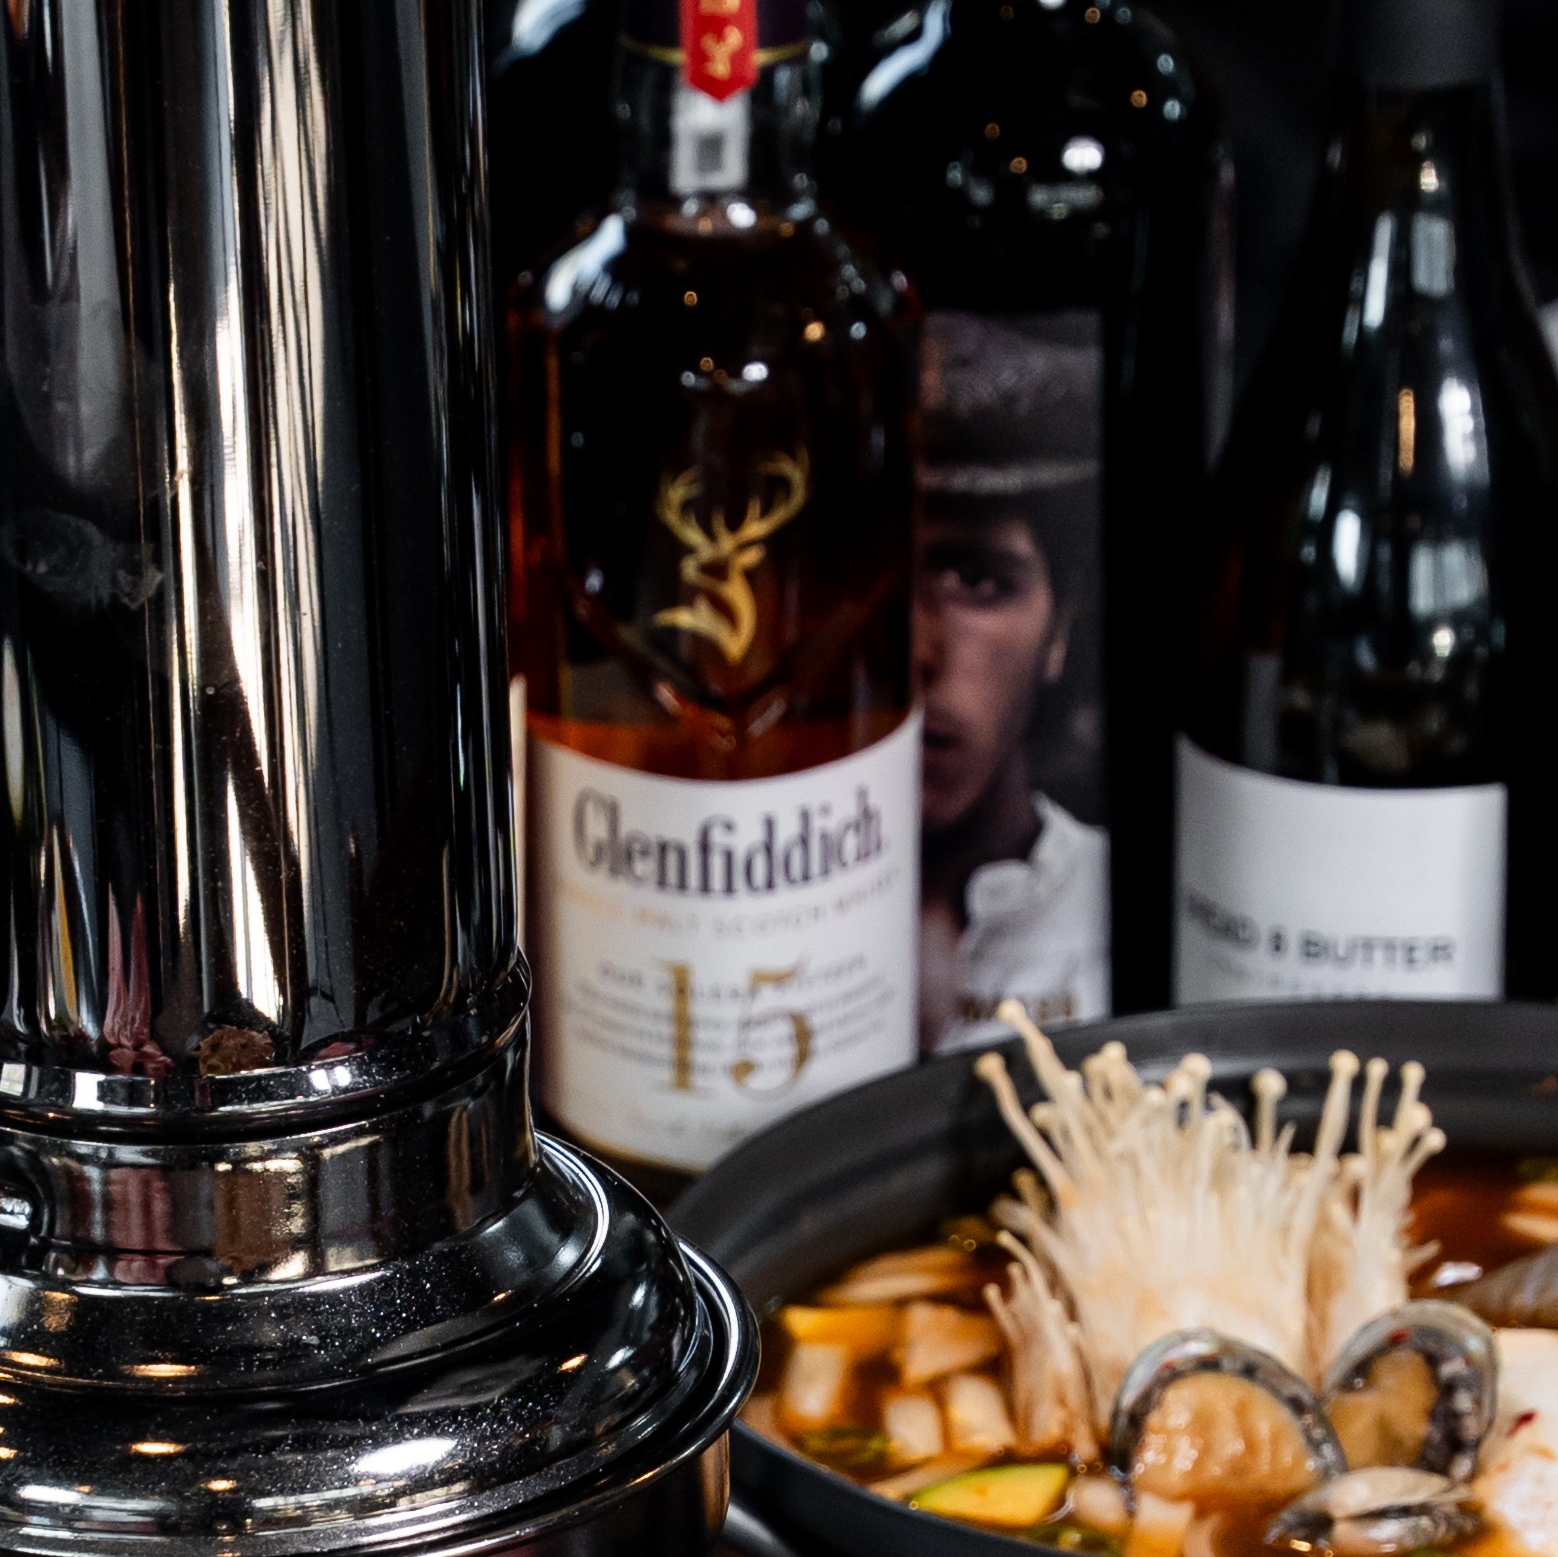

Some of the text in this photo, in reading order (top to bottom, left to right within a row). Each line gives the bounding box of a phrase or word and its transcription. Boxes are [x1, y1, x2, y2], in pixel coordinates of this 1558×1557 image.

[573, 784, 883, 899] Glenfiddich
[1298, 930, 1455, 968] BUTTER
[654, 955, 815, 1100] 15
